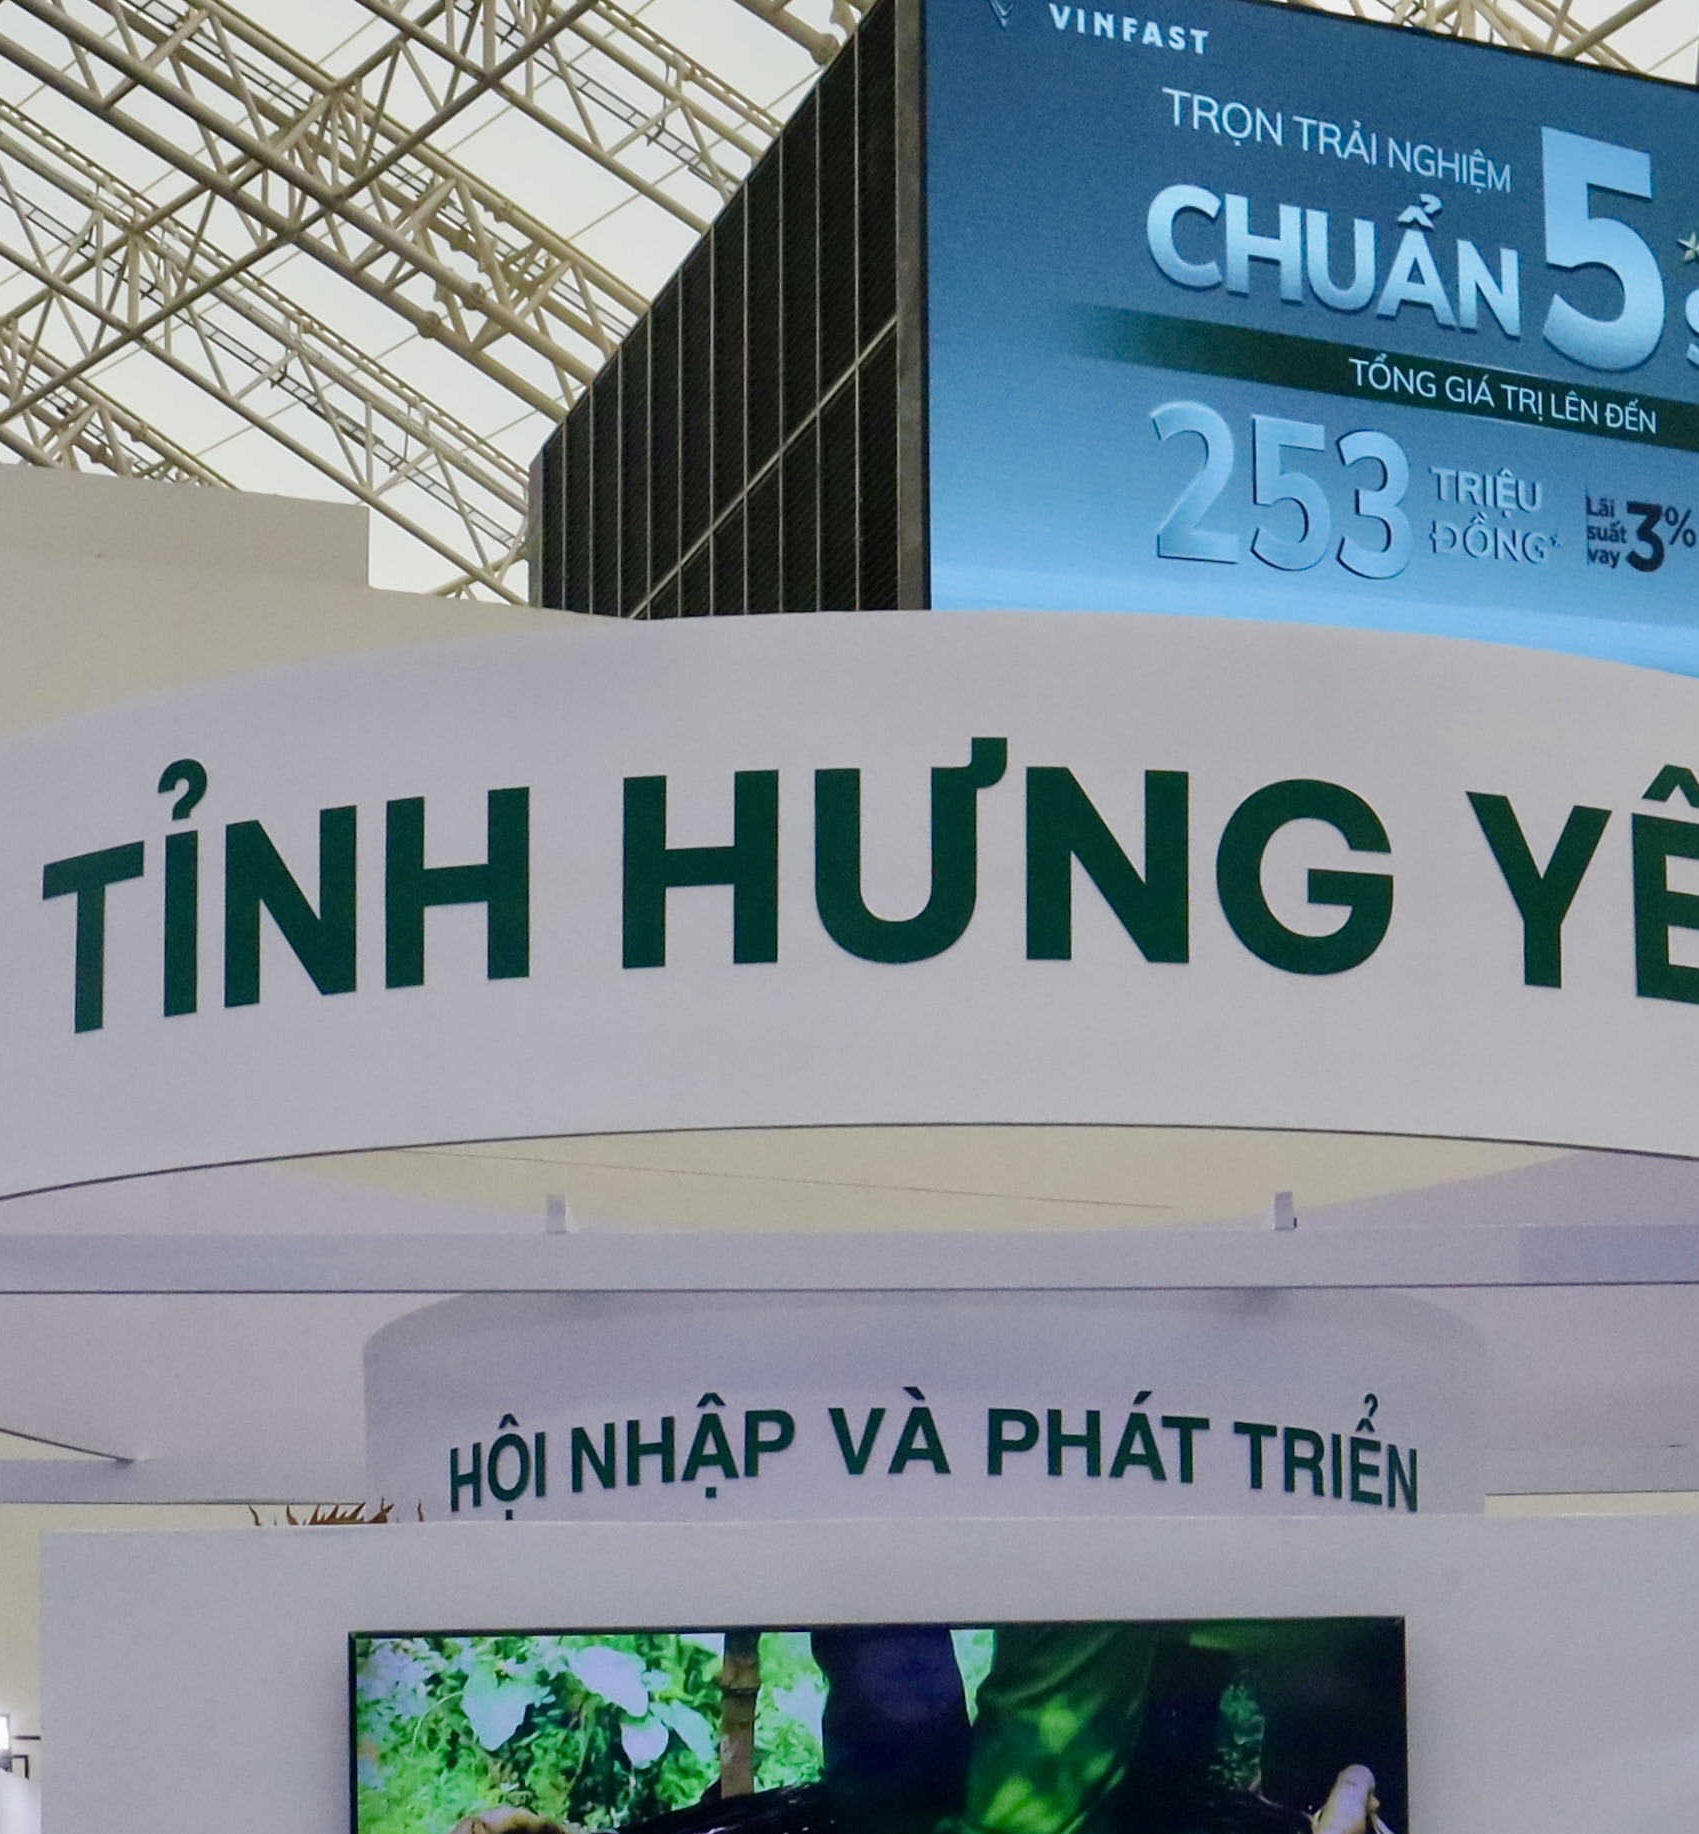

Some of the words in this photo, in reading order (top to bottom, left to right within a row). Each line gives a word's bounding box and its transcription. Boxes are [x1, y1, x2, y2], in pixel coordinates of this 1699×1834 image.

[1049, 3, 1209, 55] VINFAST
[1162, 87, 1283, 147] TRỌN
[1293, 116, 1377, 166] TRẢI
[1388, 134, 1512, 196] NGHIỆM
[1147, 194, 1521, 338] CHUẨN
[1540, 127, 1667, 371] 5
[1349, 352, 1437, 400] TỔNG
[1446, 371, 1495, 410] GIÁ
[1501, 381, 1545, 422] TRỊ
[1551, 384, 1599, 427] LÊN
[1604, 393, 1658, 434] ĐẾN
[1149, 401, 1410, 580] 253
[1431, 466, 1543, 516] TRIỆU
[1586, 495, 1615, 518] Lãi
[1587, 521, 1627, 544] suất
[1588, 547, 1621, 569] vay
[42, 758, 529, 1033] TỈNH
[623, 736, 1394, 975] HƯNG
[450, 1413, 546, 1520] HỘI
[571, 1392, 795, 1498] NHẬP
[828, 1386, 950, 1474] VÀ
[988, 1390, 1210, 1483] PHÁT
[1234, 1392, 1418, 1511] TRIỂN
